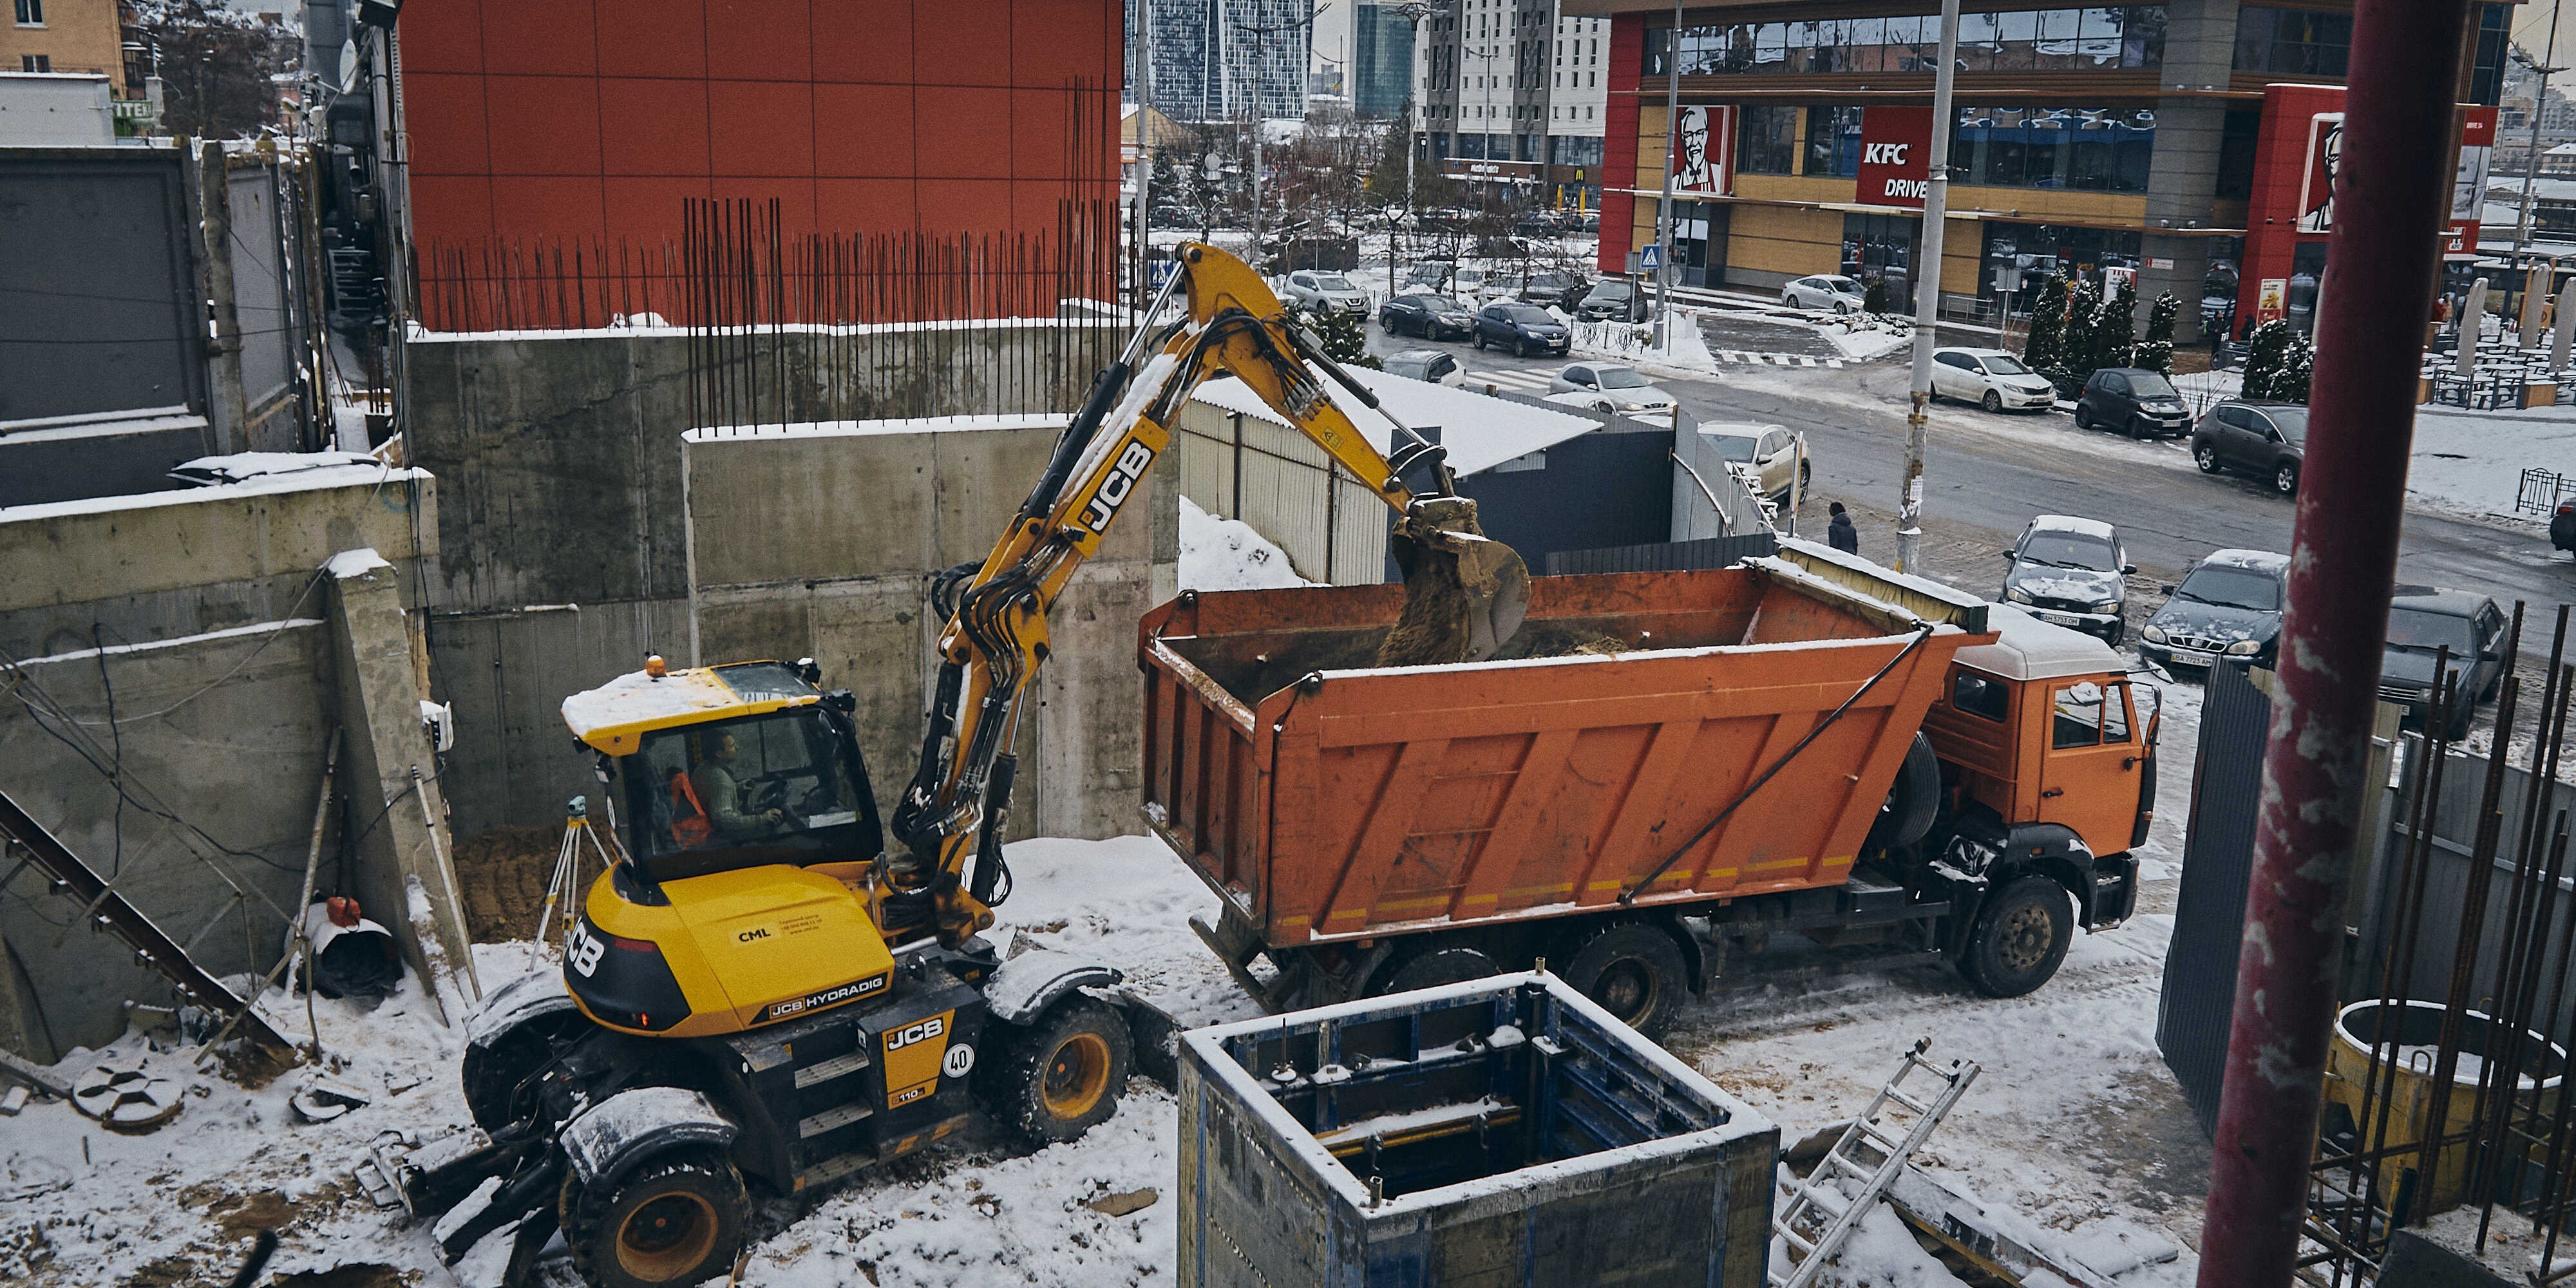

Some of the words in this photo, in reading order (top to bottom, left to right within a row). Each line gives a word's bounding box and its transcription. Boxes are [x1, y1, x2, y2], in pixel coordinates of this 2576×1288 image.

[1863, 143, 1908, 165] KFC
[1884, 178, 1927, 199] DRIVE
[1090, 442, 1151, 531] JCB
[569, 916, 605, 978] CB
[738, 928, 771, 942] CML
[772, 1001, 803, 1016] JCB
[806, 977, 883, 1008] HYDRADIG
[888, 1019, 943, 1050] JCB
[951, 1050, 967, 1071] 40
